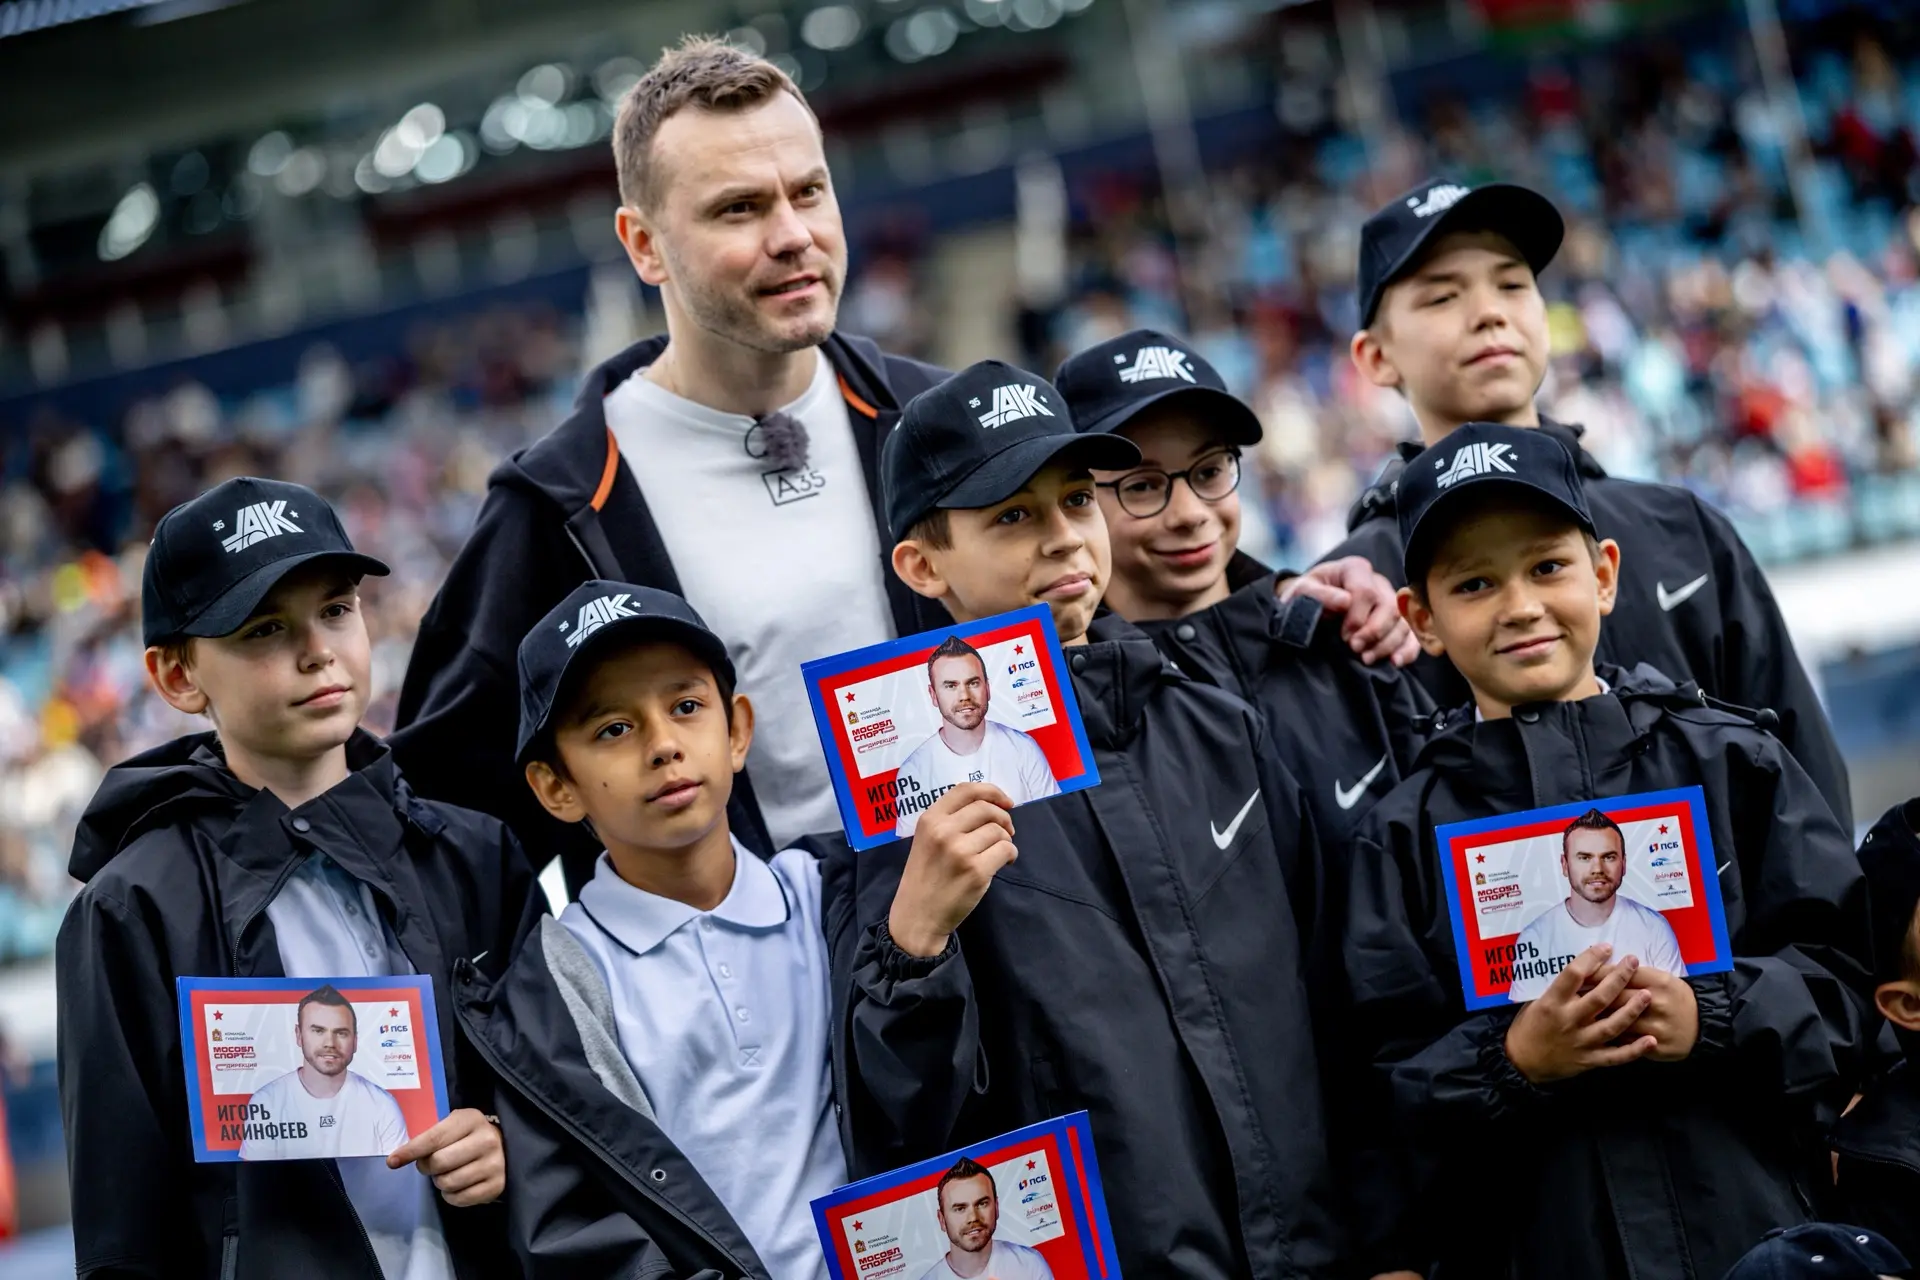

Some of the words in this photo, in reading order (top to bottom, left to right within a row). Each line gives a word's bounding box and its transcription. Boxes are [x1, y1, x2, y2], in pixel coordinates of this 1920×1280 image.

[1018, 660, 1036, 671] ПСБ
[853, 728, 886, 742] СПОРТ
[866, 775, 921, 805] ИГОРЬ
[874, 783, 956, 824] АКИНФЕ
[1660, 841, 1679, 850] ПСБ
[1478, 892, 1511, 902] СПОРТ
[1484, 941, 1540, 965] ИГОРЬ
[391, 1025, 408, 1033] ПСБ
[217, 1104, 271, 1121] ИГОРЬ
[221, 1122, 308, 1141] АКИНФЕЕВ
[1029, 1175, 1047, 1185] ПСБ
[860, 1256, 893, 1271] СПОРТ
